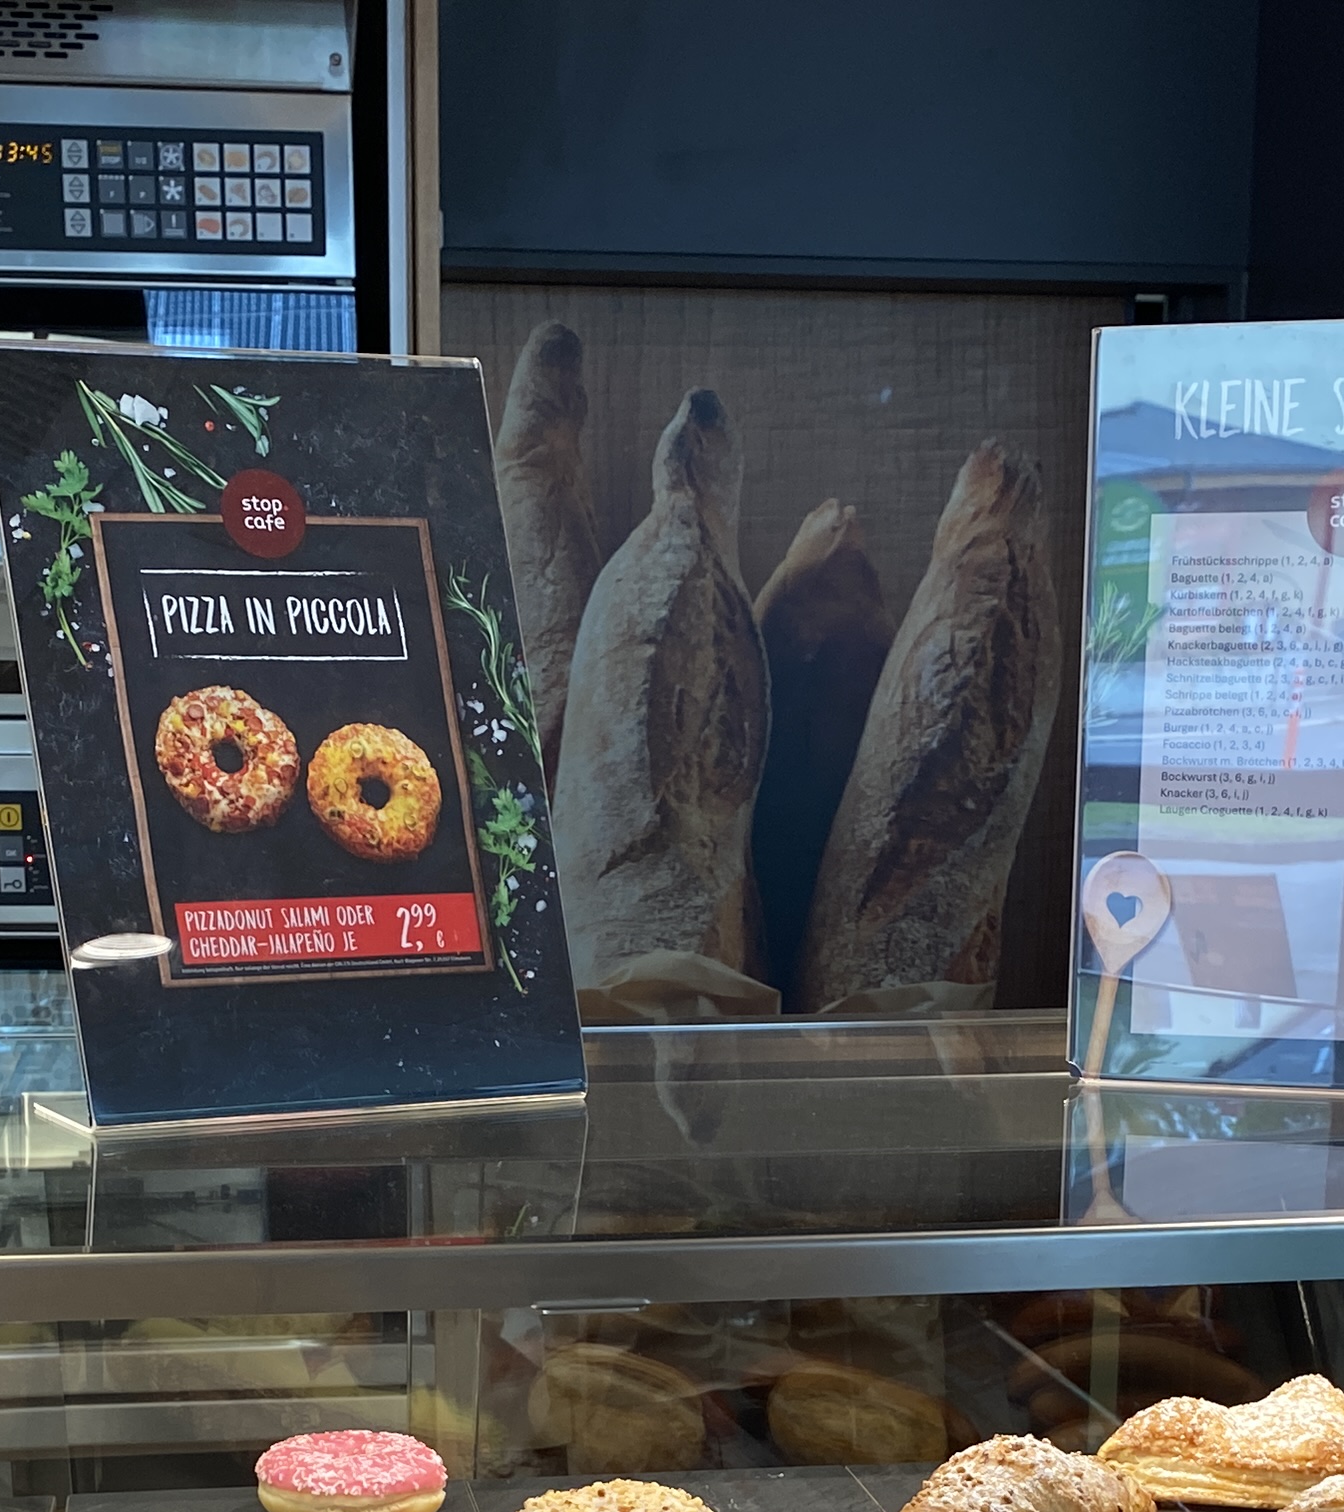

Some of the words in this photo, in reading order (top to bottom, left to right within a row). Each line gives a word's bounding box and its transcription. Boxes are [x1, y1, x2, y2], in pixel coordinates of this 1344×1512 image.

[1174, 378, 1307, 440] KLEINE
[241, 496, 282, 514] stop
[244, 513, 285, 531] cafe
[162, 595, 234, 634] PIZZA
[247, 597, 275, 634] IN
[288, 598, 392, 636] PICCOLA
[1168, 641, 1258, 652] Knackerbaguette
[1161, 772, 1217, 782] Bockwurst
[1160, 788, 1203, 798] Knacker
[184, 909, 273, 932] PIZZADONUT
[281, 906, 330, 928] SALAMI
[336, 904, 375, 927] ODER
[189, 931, 335, 959] CHEDDAR-JALAPEÑO
[343, 930, 358, 952] JE
